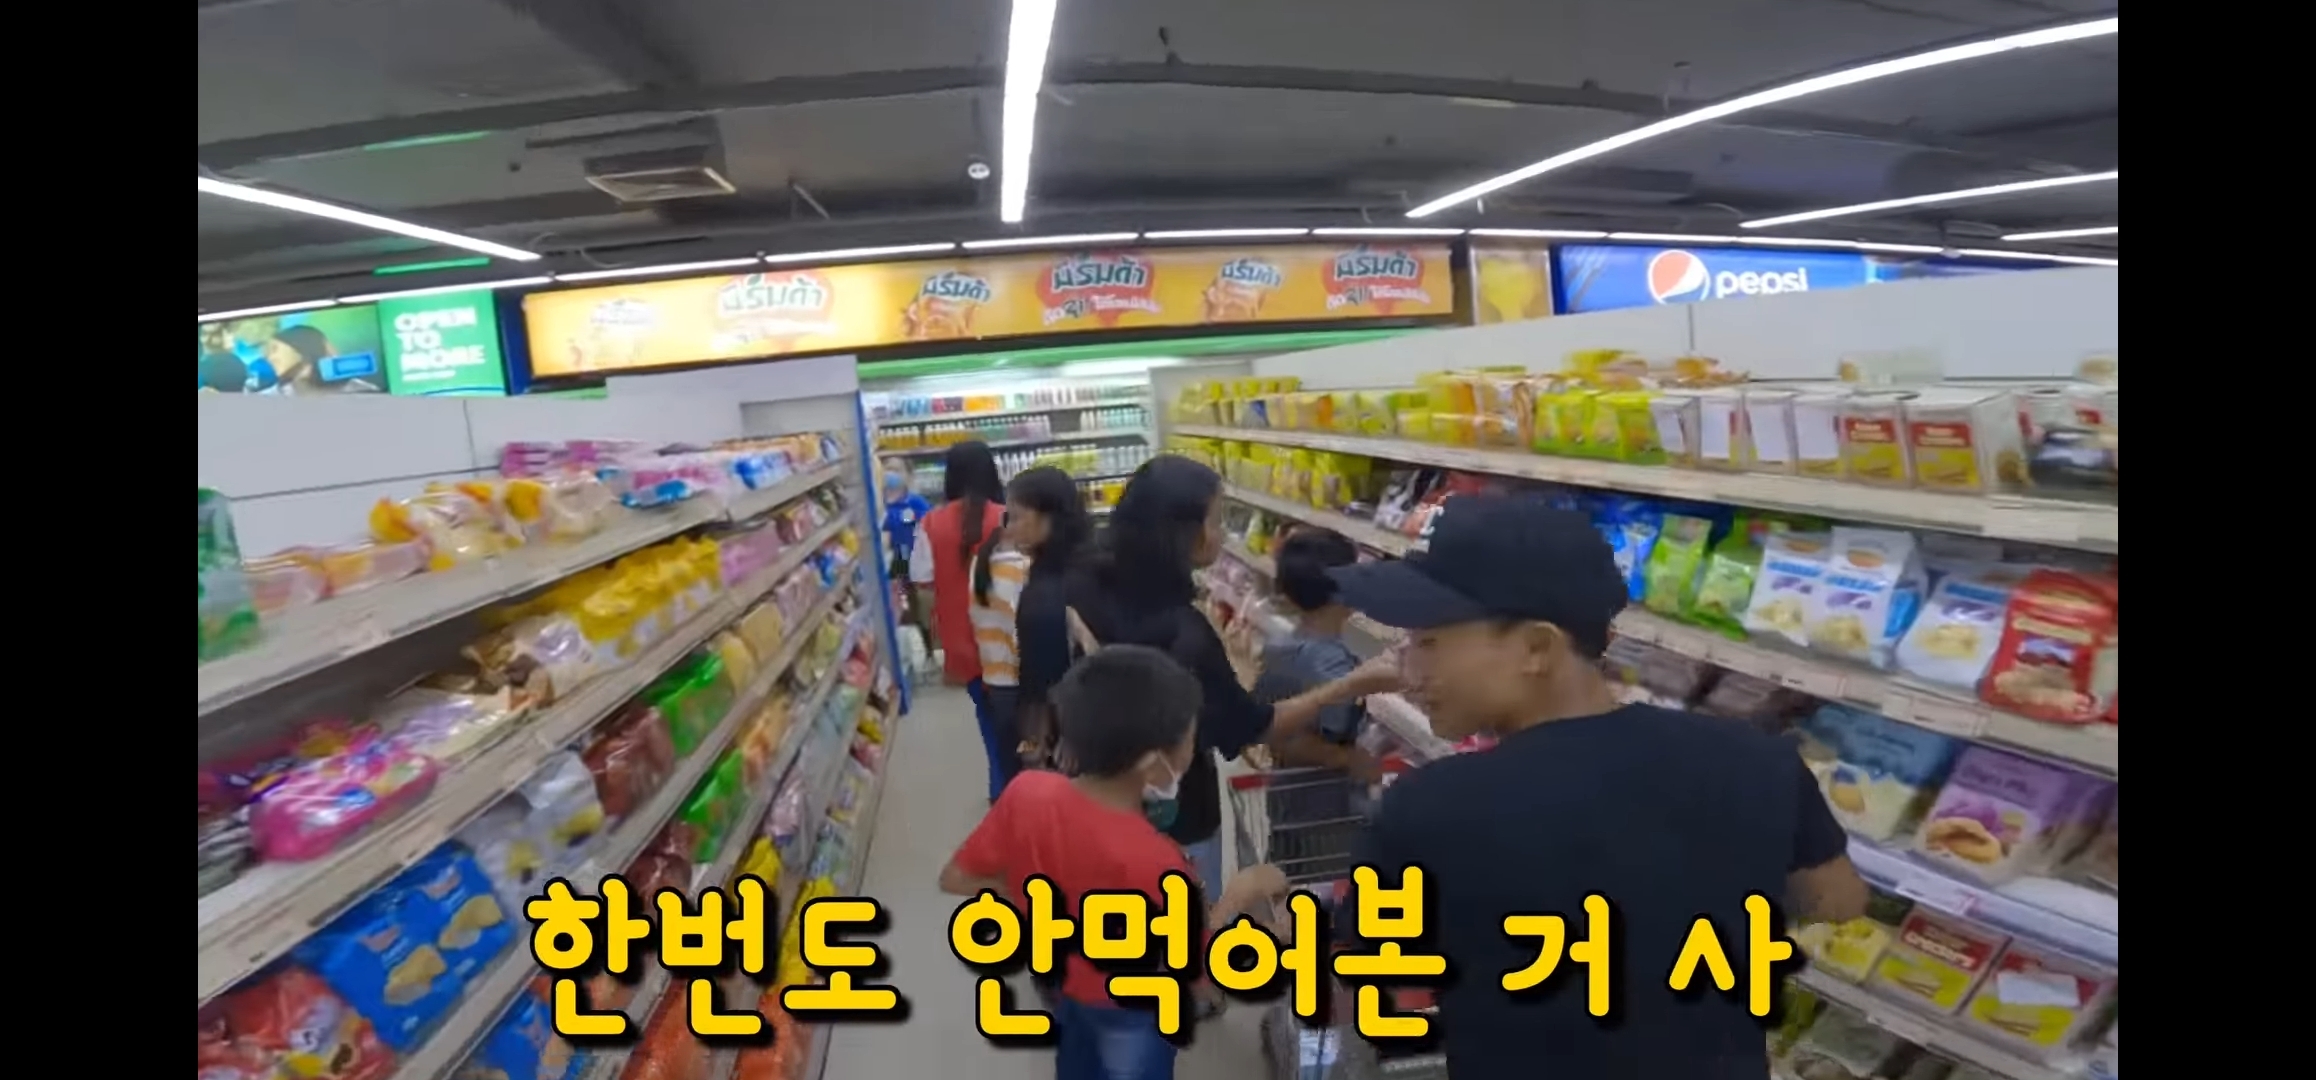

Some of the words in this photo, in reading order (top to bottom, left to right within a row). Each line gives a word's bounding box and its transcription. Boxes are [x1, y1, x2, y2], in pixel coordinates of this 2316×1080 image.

[1715, 266, 1809, 299] pepsi
[394, 306, 478, 333] OPEN
[395, 329, 442, 352] TO
[400, 344, 487, 372] MORE
